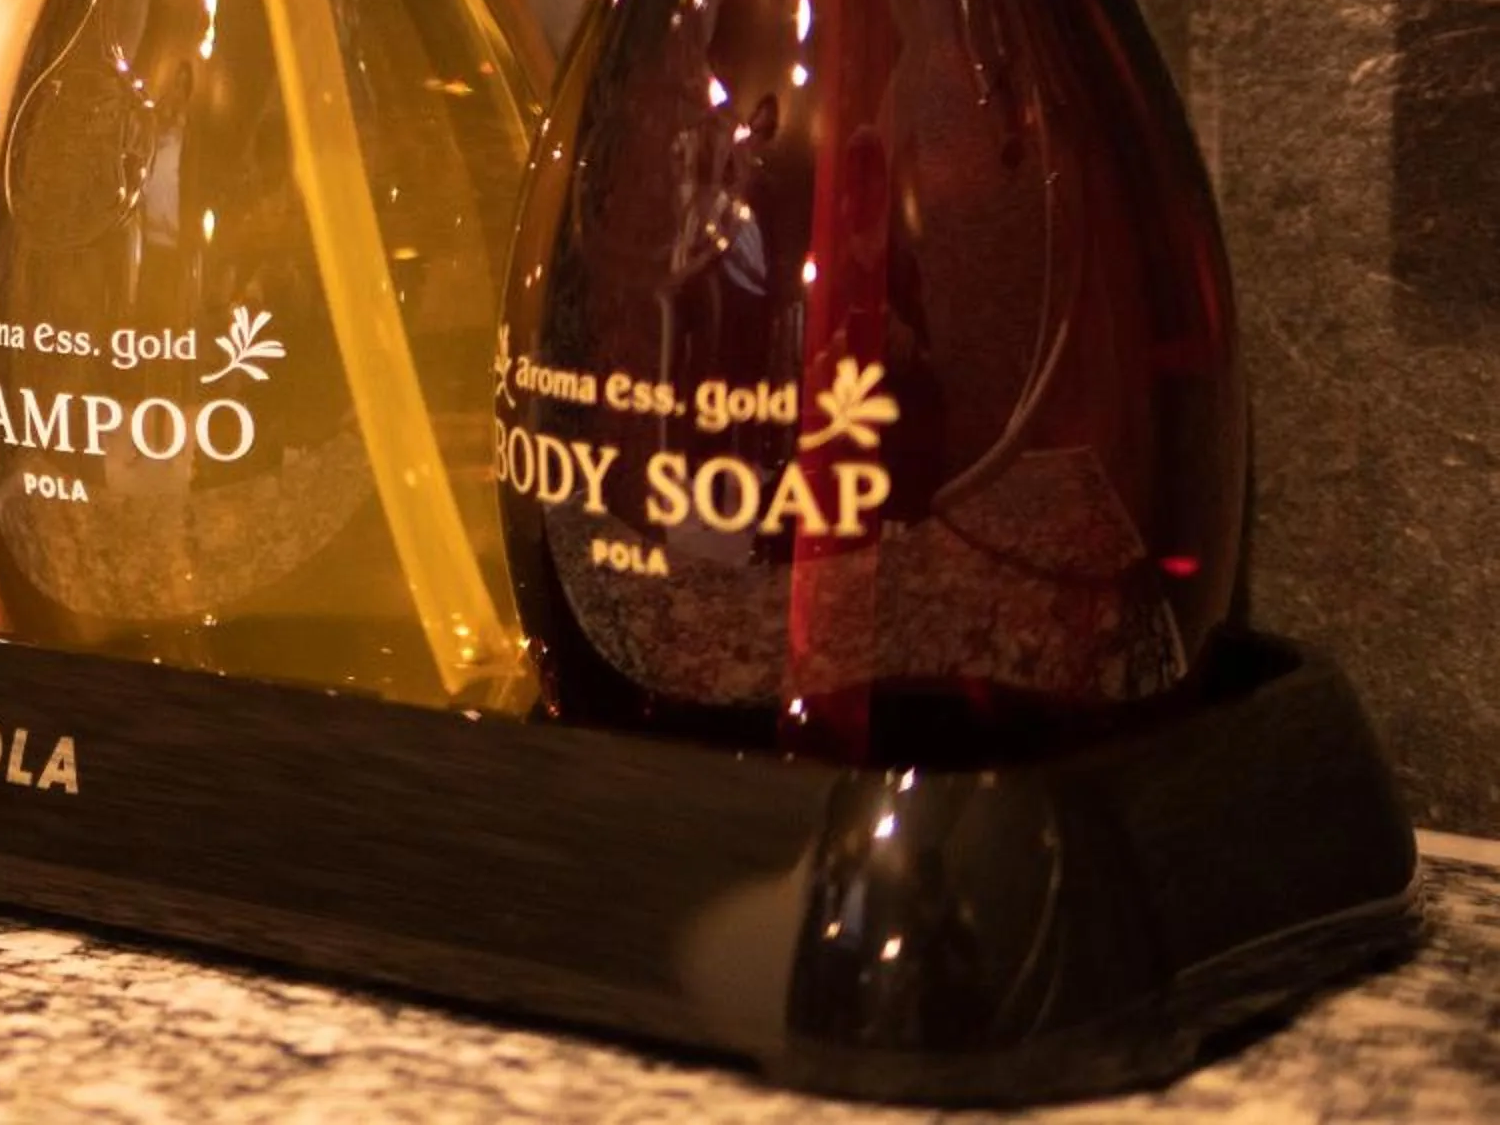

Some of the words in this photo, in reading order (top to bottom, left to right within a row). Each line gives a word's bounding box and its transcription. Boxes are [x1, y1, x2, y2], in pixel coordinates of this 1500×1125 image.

[33, 322, 100, 357] ess.
[111, 328, 198, 369] gold
[514, 355, 597, 405] aroma
[604, 371, 685, 415] ess.
[696, 380, 798, 432] gold
[22, 471, 89, 504] POLA
[495, 416, 620, 514] BODY
[645, 449, 892, 537] SOAP
[591, 537, 669, 576] POLA
